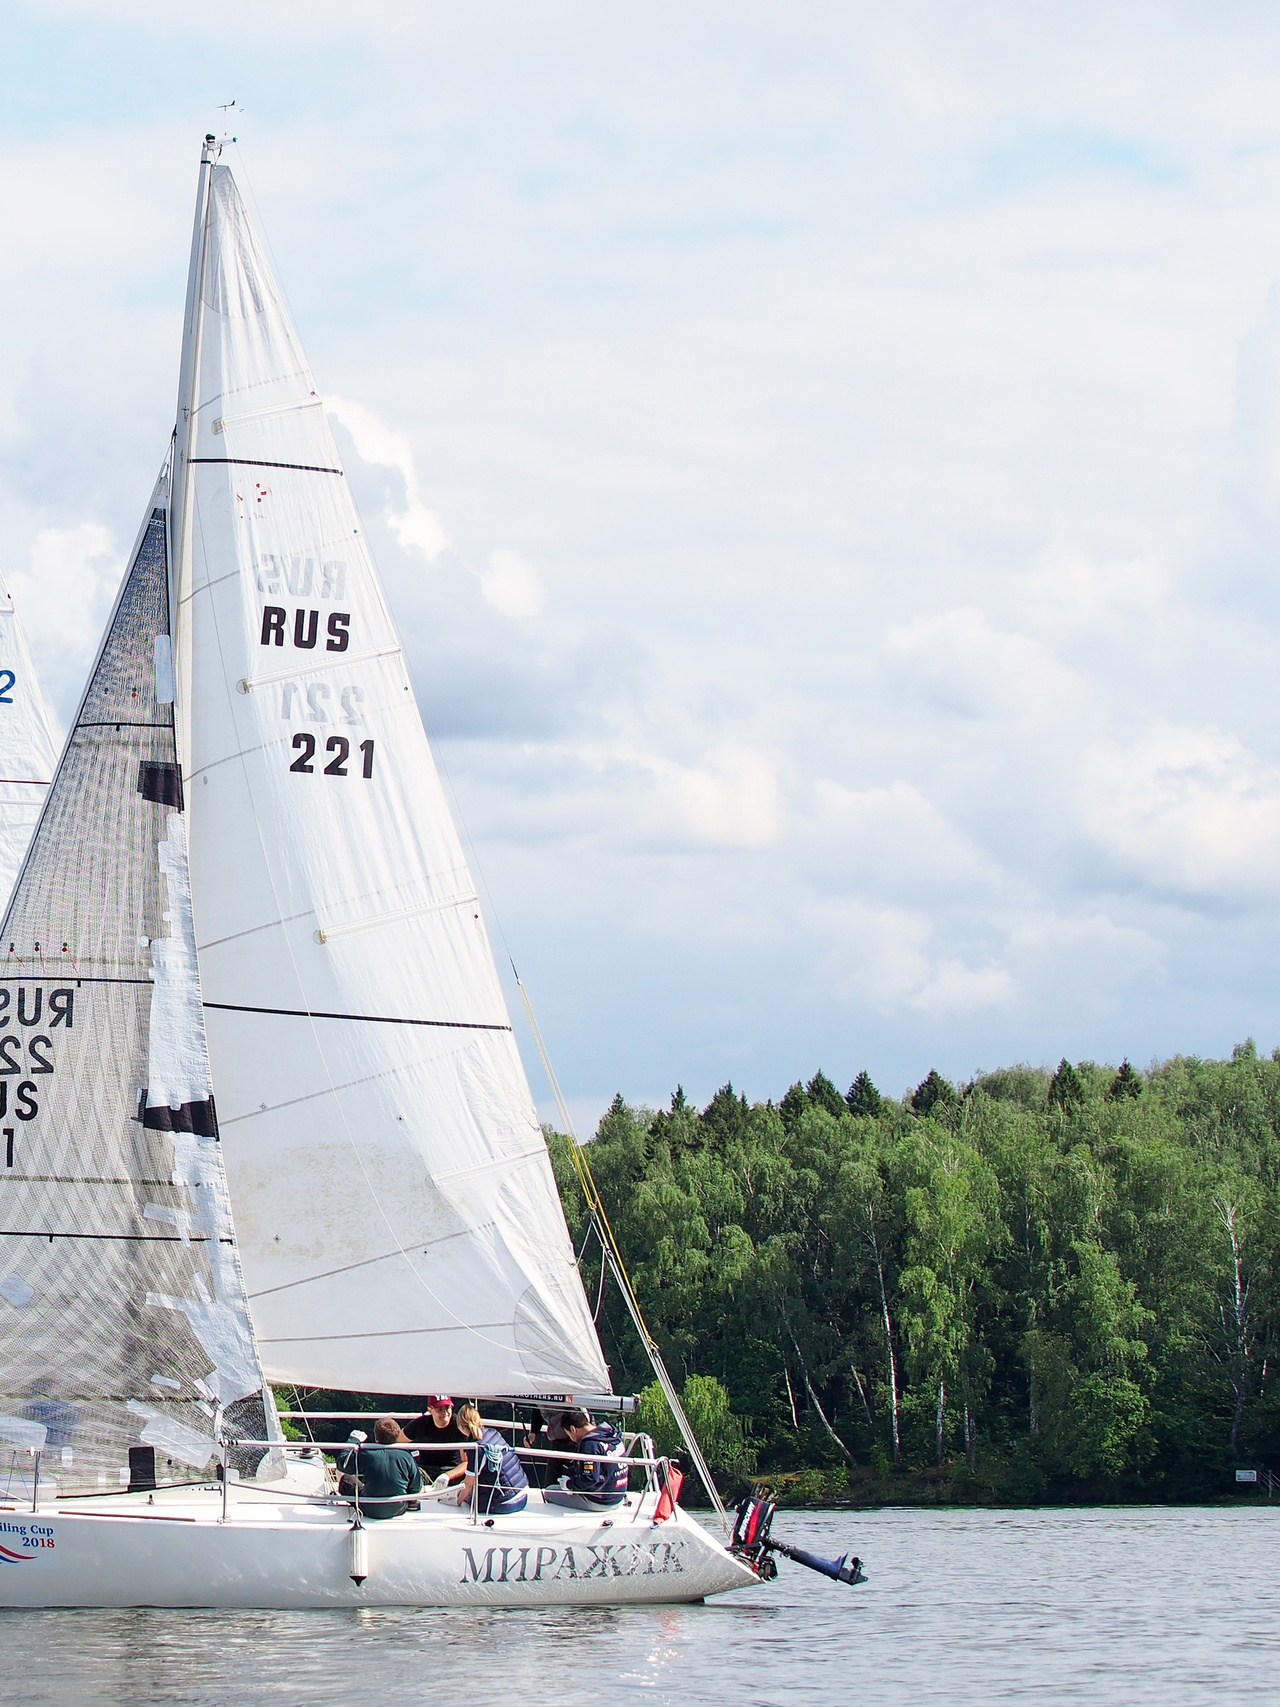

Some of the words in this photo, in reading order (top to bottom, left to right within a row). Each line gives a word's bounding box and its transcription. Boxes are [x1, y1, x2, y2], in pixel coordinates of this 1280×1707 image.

[260, 605, 351, 652] RUS
[289, 733, 375, 779] 221
[22, 1536, 55, 1548] 2018
[30, 1525, 54, 1536] Cup
[459, 1541, 690, 1584] МИРАЖИК
